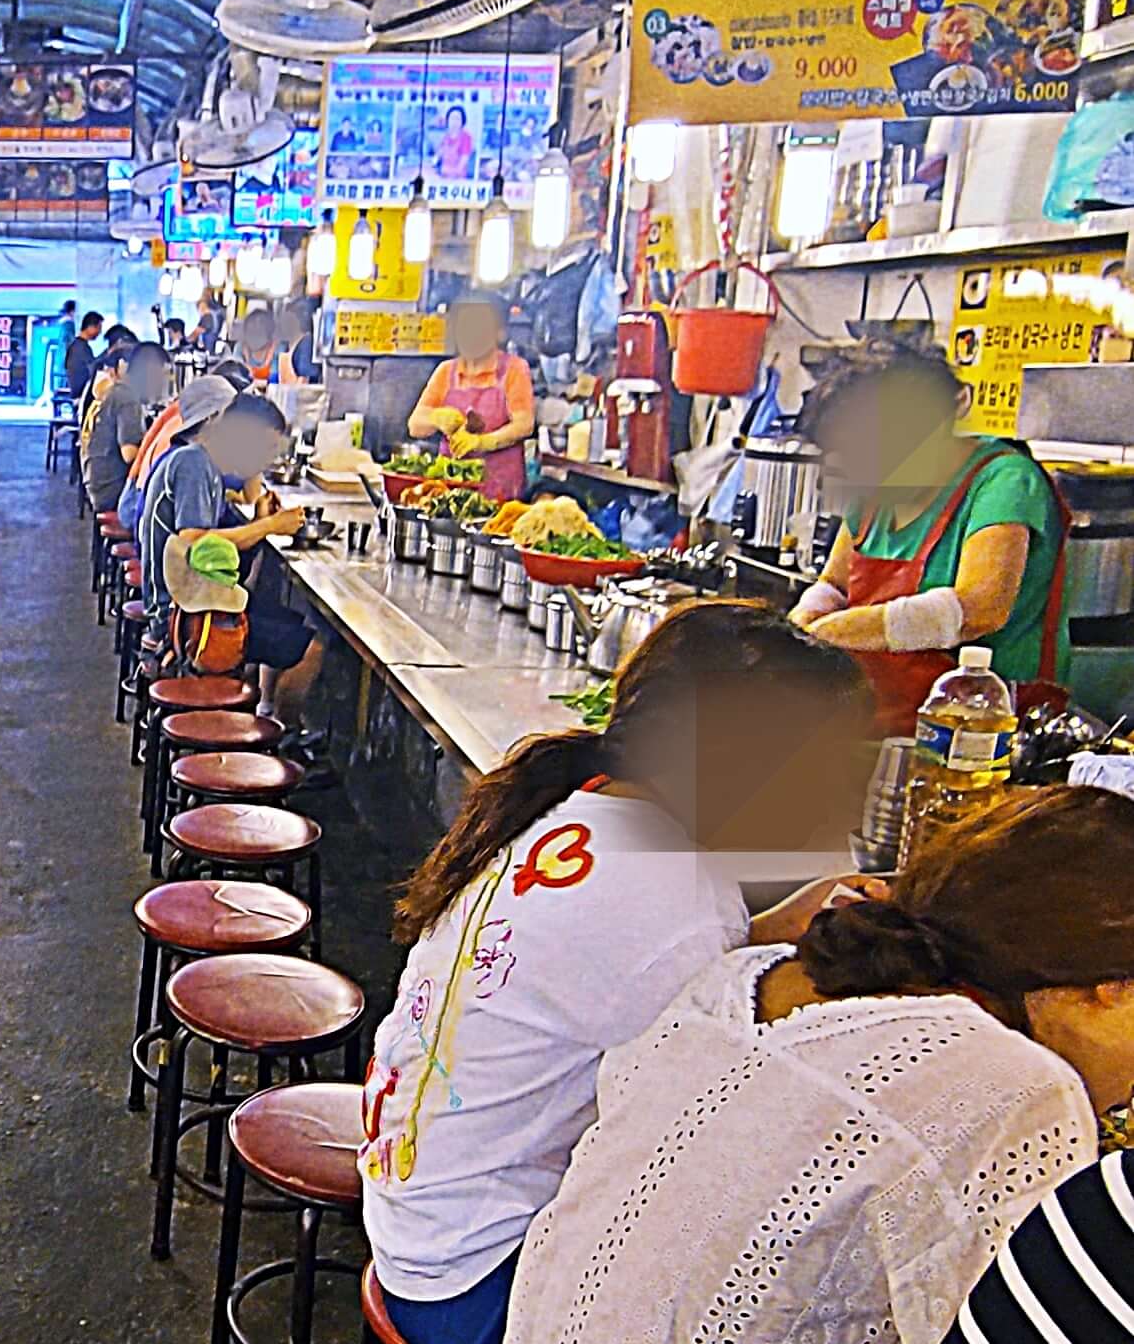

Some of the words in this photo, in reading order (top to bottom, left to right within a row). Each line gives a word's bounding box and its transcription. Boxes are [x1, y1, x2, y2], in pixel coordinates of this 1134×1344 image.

[645, 16, 667, 33] 03
[872, 12, 903, 29] 세트
[1013, 81, 1069, 104] 6,000
